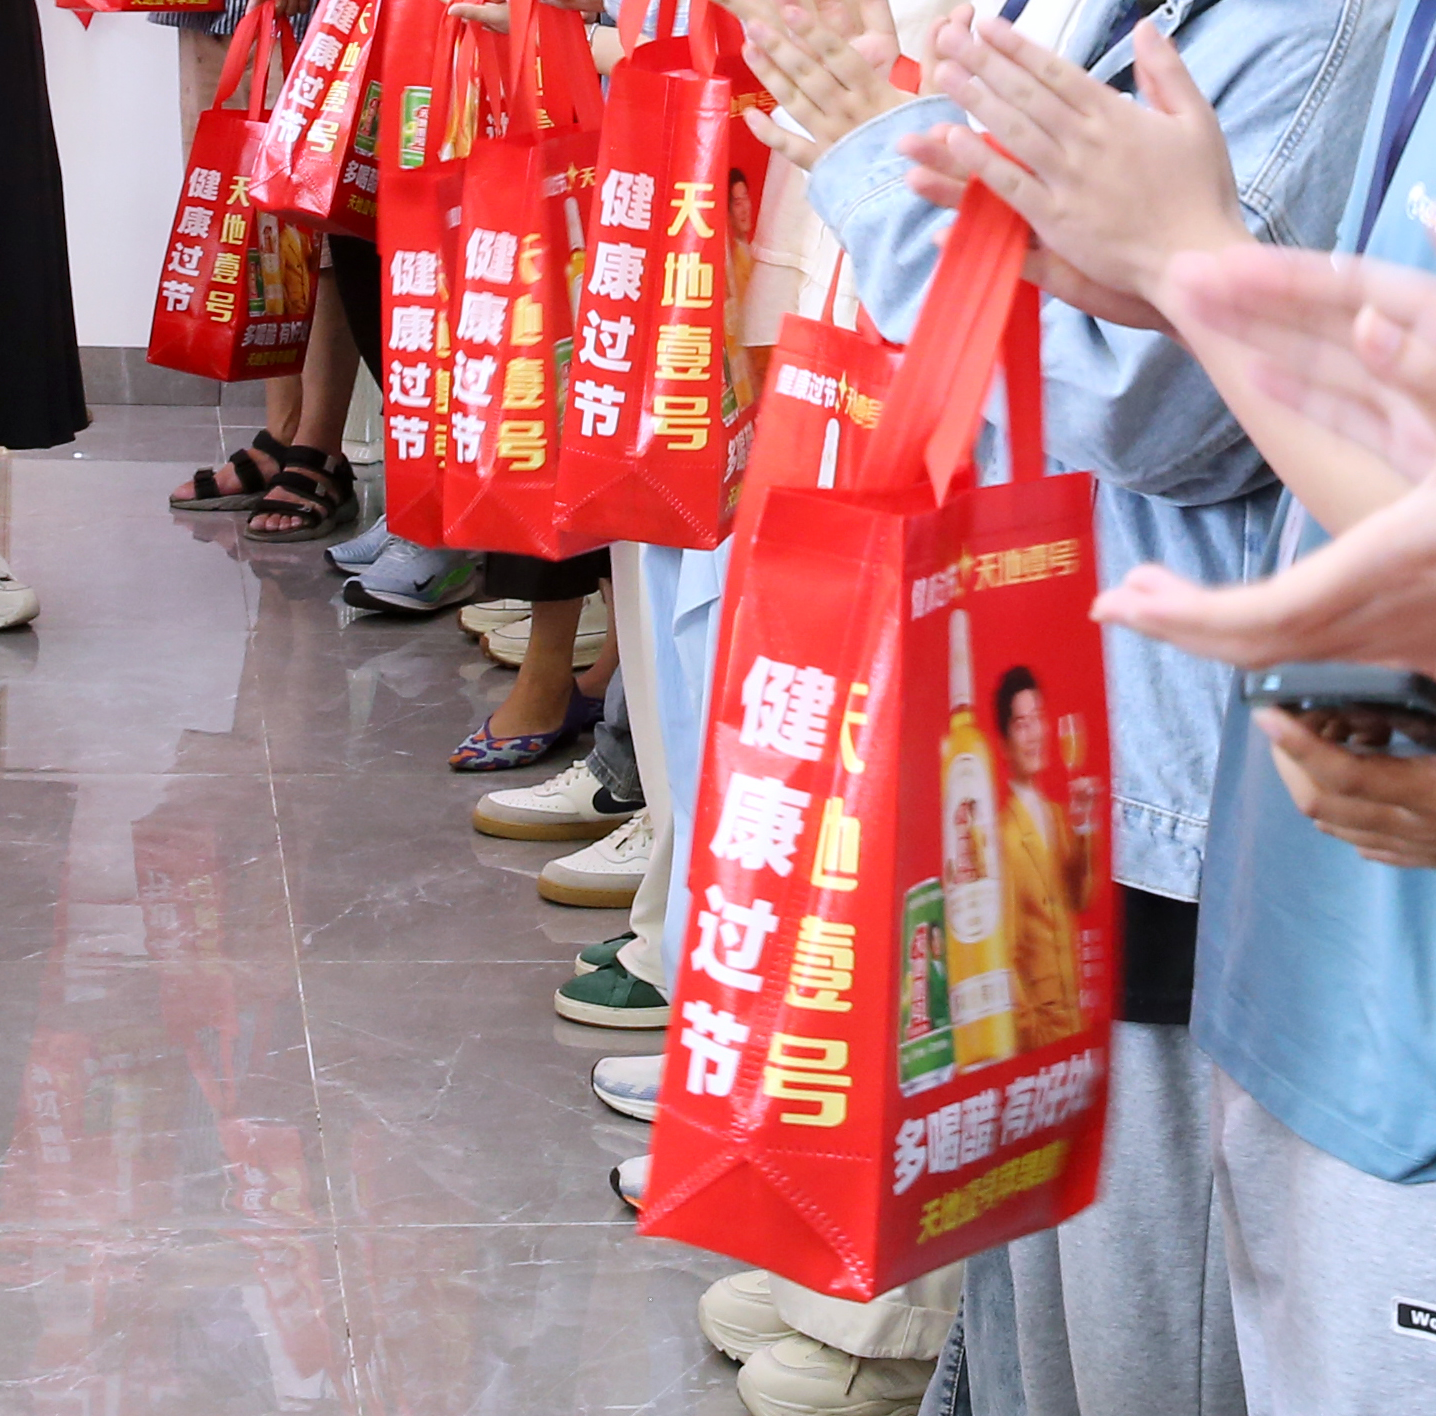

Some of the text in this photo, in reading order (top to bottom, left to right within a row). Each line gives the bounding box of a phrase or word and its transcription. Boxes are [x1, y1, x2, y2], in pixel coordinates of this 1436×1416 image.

[305, 2, 372, 154] 天地壹号
[161, 166, 222, 313] 健康过节
[205, 174, 251, 324] 天地壹号
[451, 225, 519, 465] 健康过节
[573, 167, 656, 440] 健康过节
[651, 181, 716, 453] 天地壹号
[388, 249, 439, 461] 健康过节
[681, 655, 836, 1098] 健康过节
[893, 1048, 1107, 1196] 多喝醋 有好处
